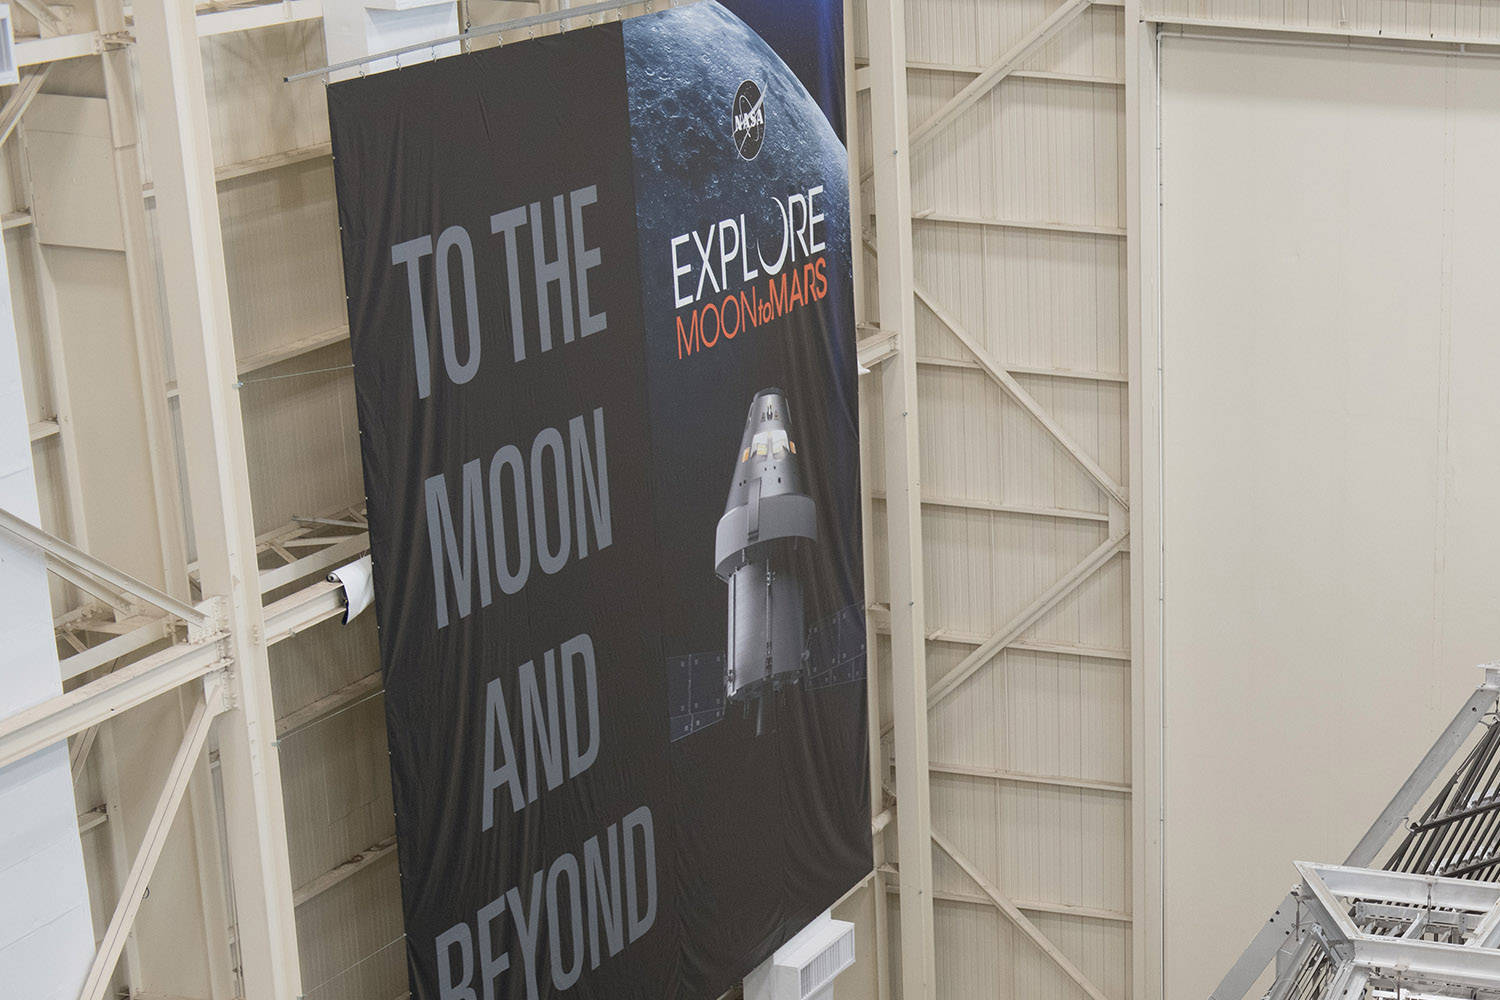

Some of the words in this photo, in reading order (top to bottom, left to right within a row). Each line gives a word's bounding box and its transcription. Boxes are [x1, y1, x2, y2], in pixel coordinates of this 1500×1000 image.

[735, 109, 764, 131] NASA
[391, 225, 481, 400] TO
[490, 184, 608, 362] THE
[670, 184, 826, 309] EXPLORE
[424, 407, 613, 629] MOON
[481, 633, 600, 832] AND
